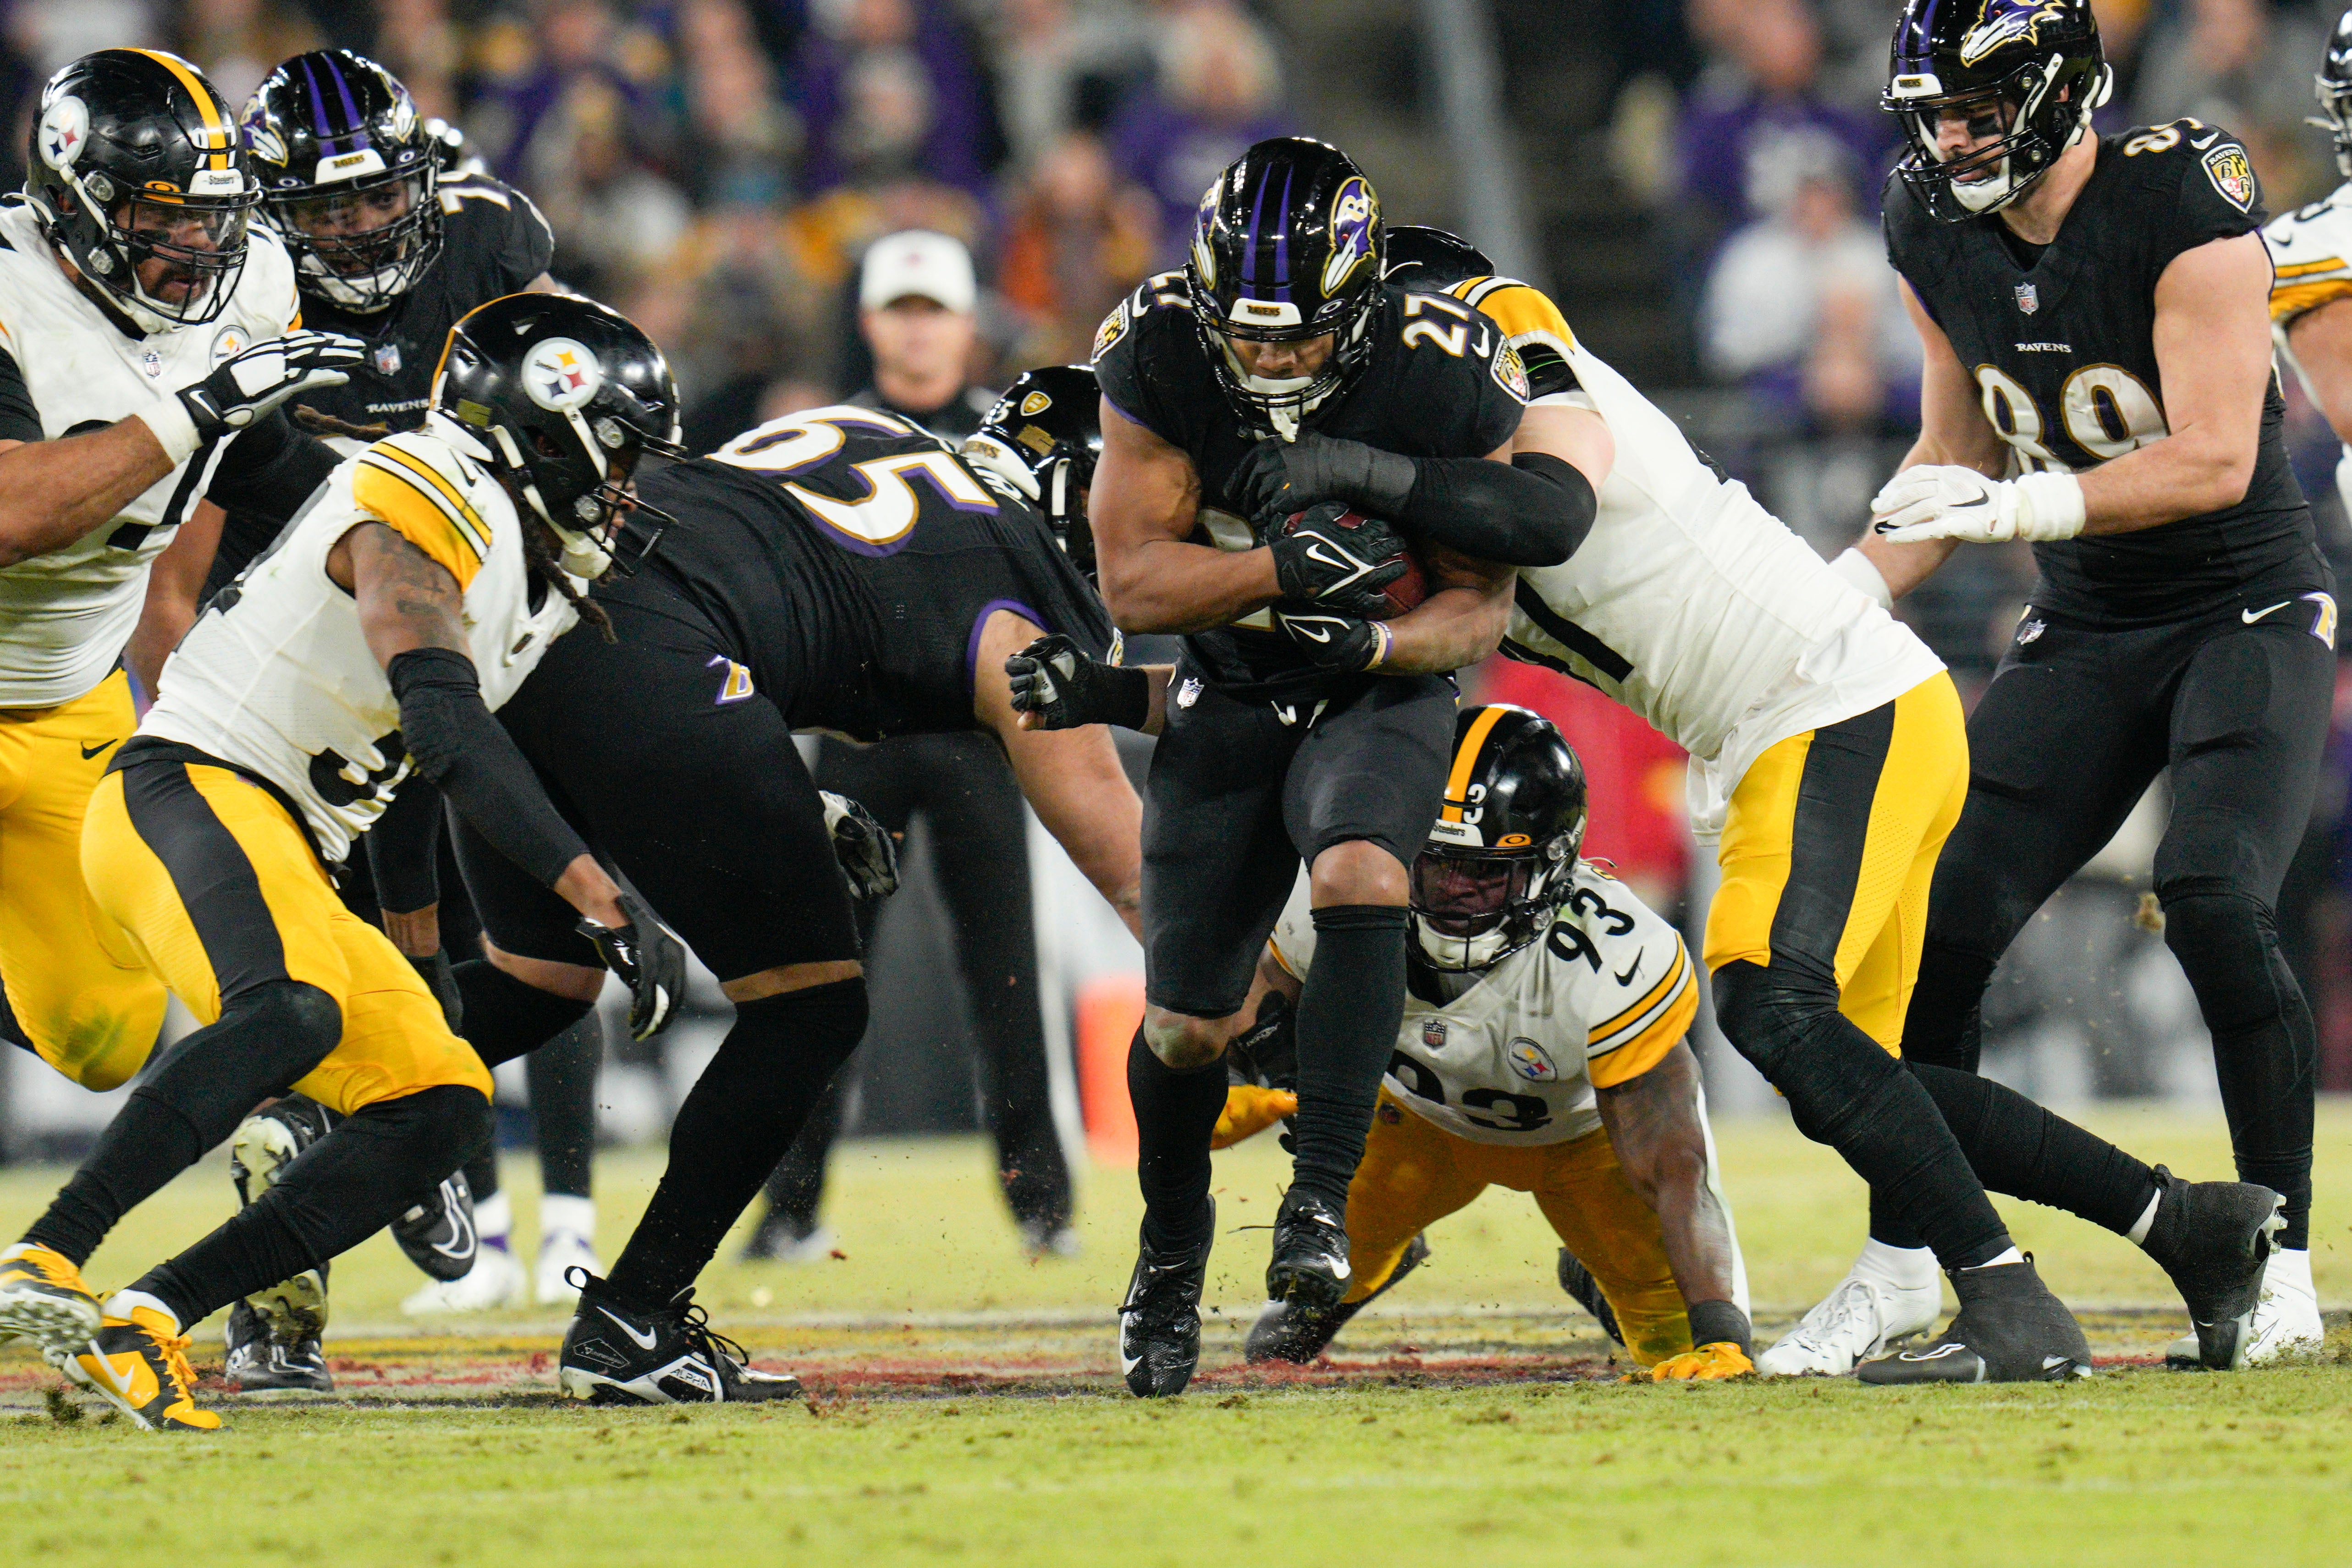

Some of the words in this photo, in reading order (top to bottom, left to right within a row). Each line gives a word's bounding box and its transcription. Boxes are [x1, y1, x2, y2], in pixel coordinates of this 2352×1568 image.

[2208, 149, 2241, 165] RAVENS
[1402, 294, 1470, 358] 27
[2014, 343, 2072, 353] RAVENS
[705, 405, 1000, 557] 65
[1547, 887, 1635, 974] 93
[669, 1368, 709, 1390] ALPHA
